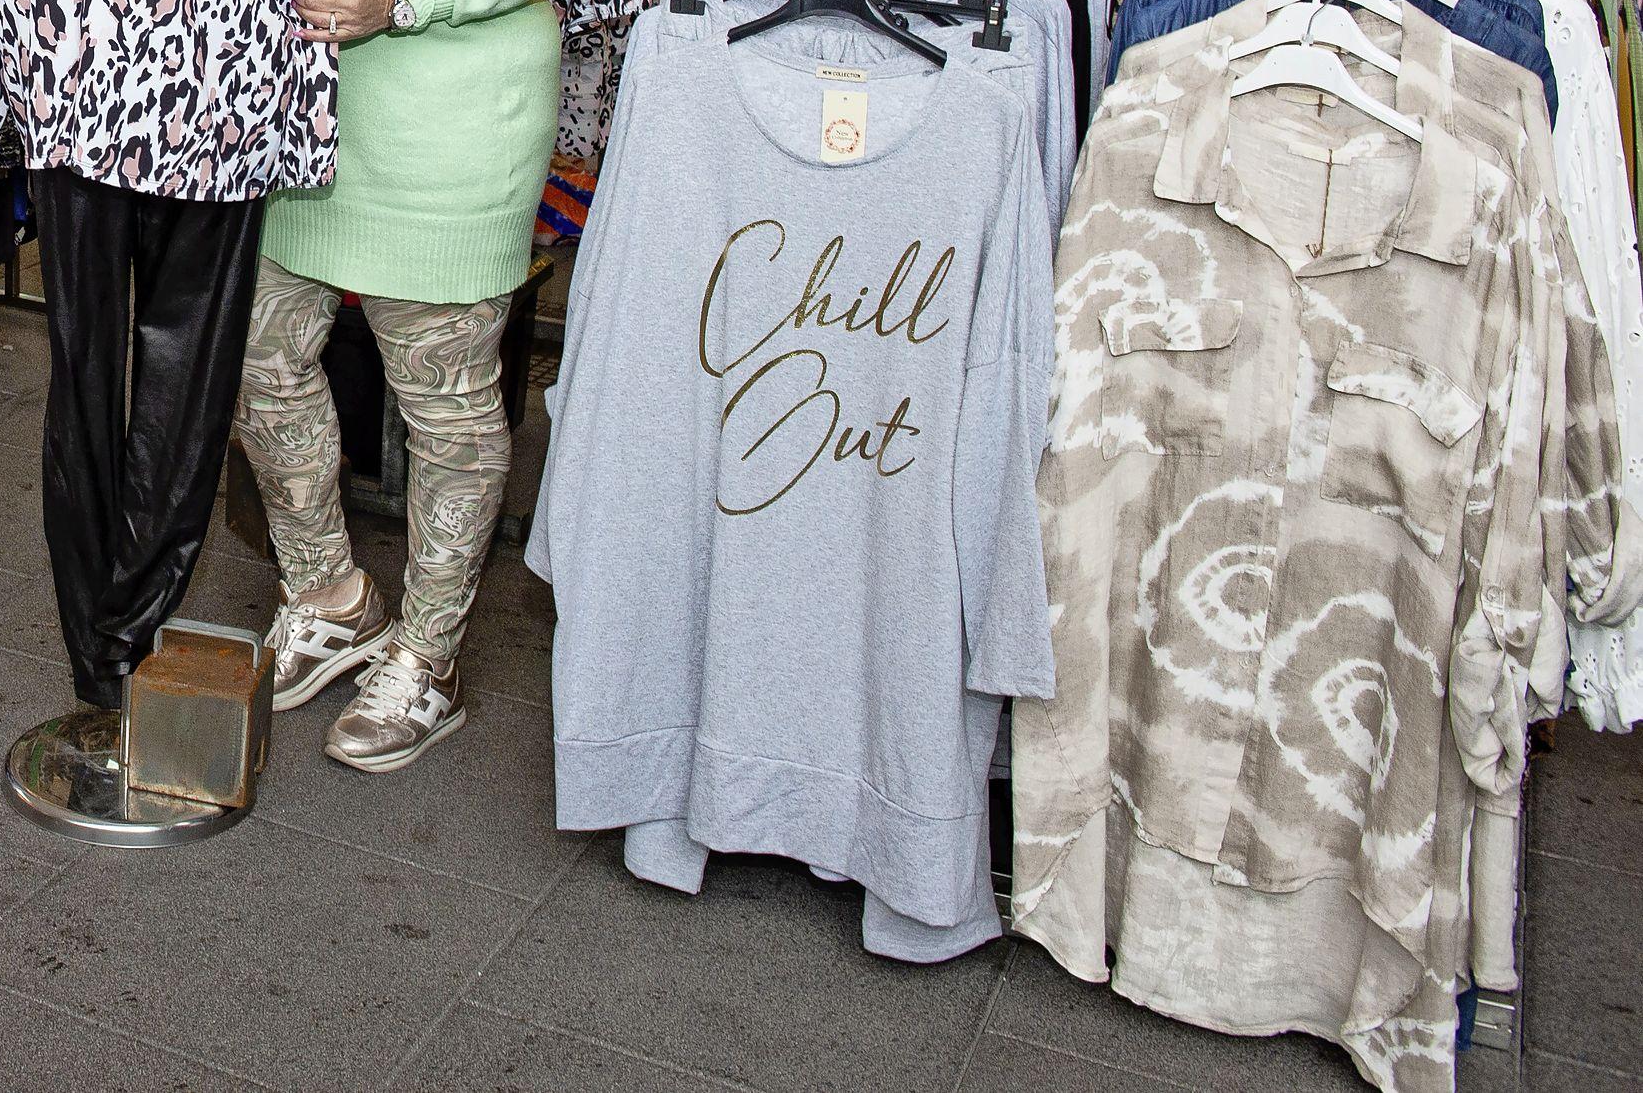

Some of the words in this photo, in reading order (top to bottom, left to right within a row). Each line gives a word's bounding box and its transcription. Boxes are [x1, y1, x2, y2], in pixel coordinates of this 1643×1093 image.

[832, 70, 861, 79] COLLECTION
[699, 219, 956, 379] Chill
[716, 349, 921, 516] Out
